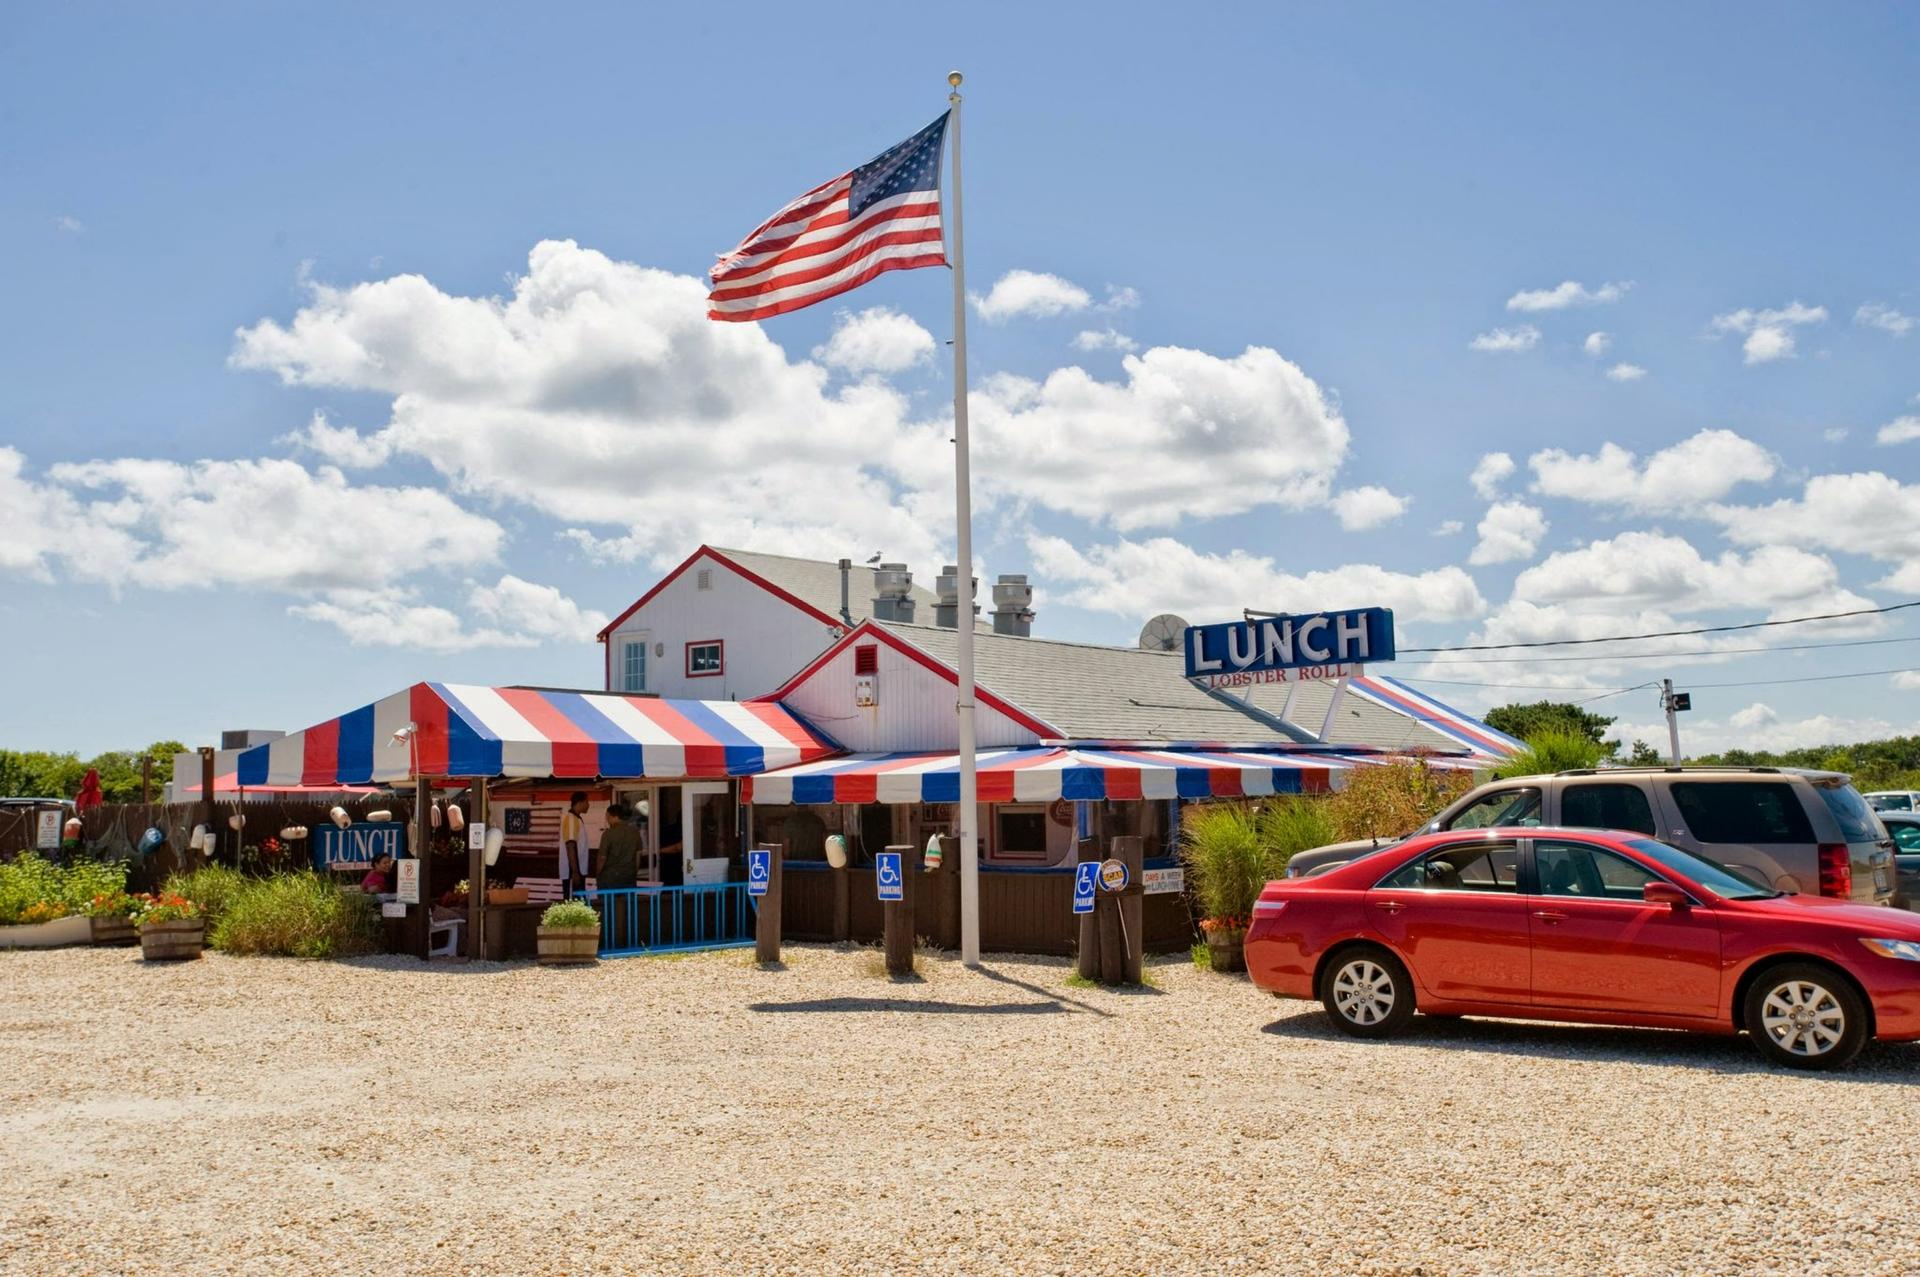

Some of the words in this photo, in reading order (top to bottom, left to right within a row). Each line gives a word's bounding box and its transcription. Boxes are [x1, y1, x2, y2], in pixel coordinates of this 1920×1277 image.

[1193, 612, 1369, 672] LUNCH
[1210, 669, 1287, 689] LOBSTER
[1299, 664, 1347, 680] ROLL
[325, 829, 399, 864] LUNCH
[879, 886, 901, 895] PARKING
